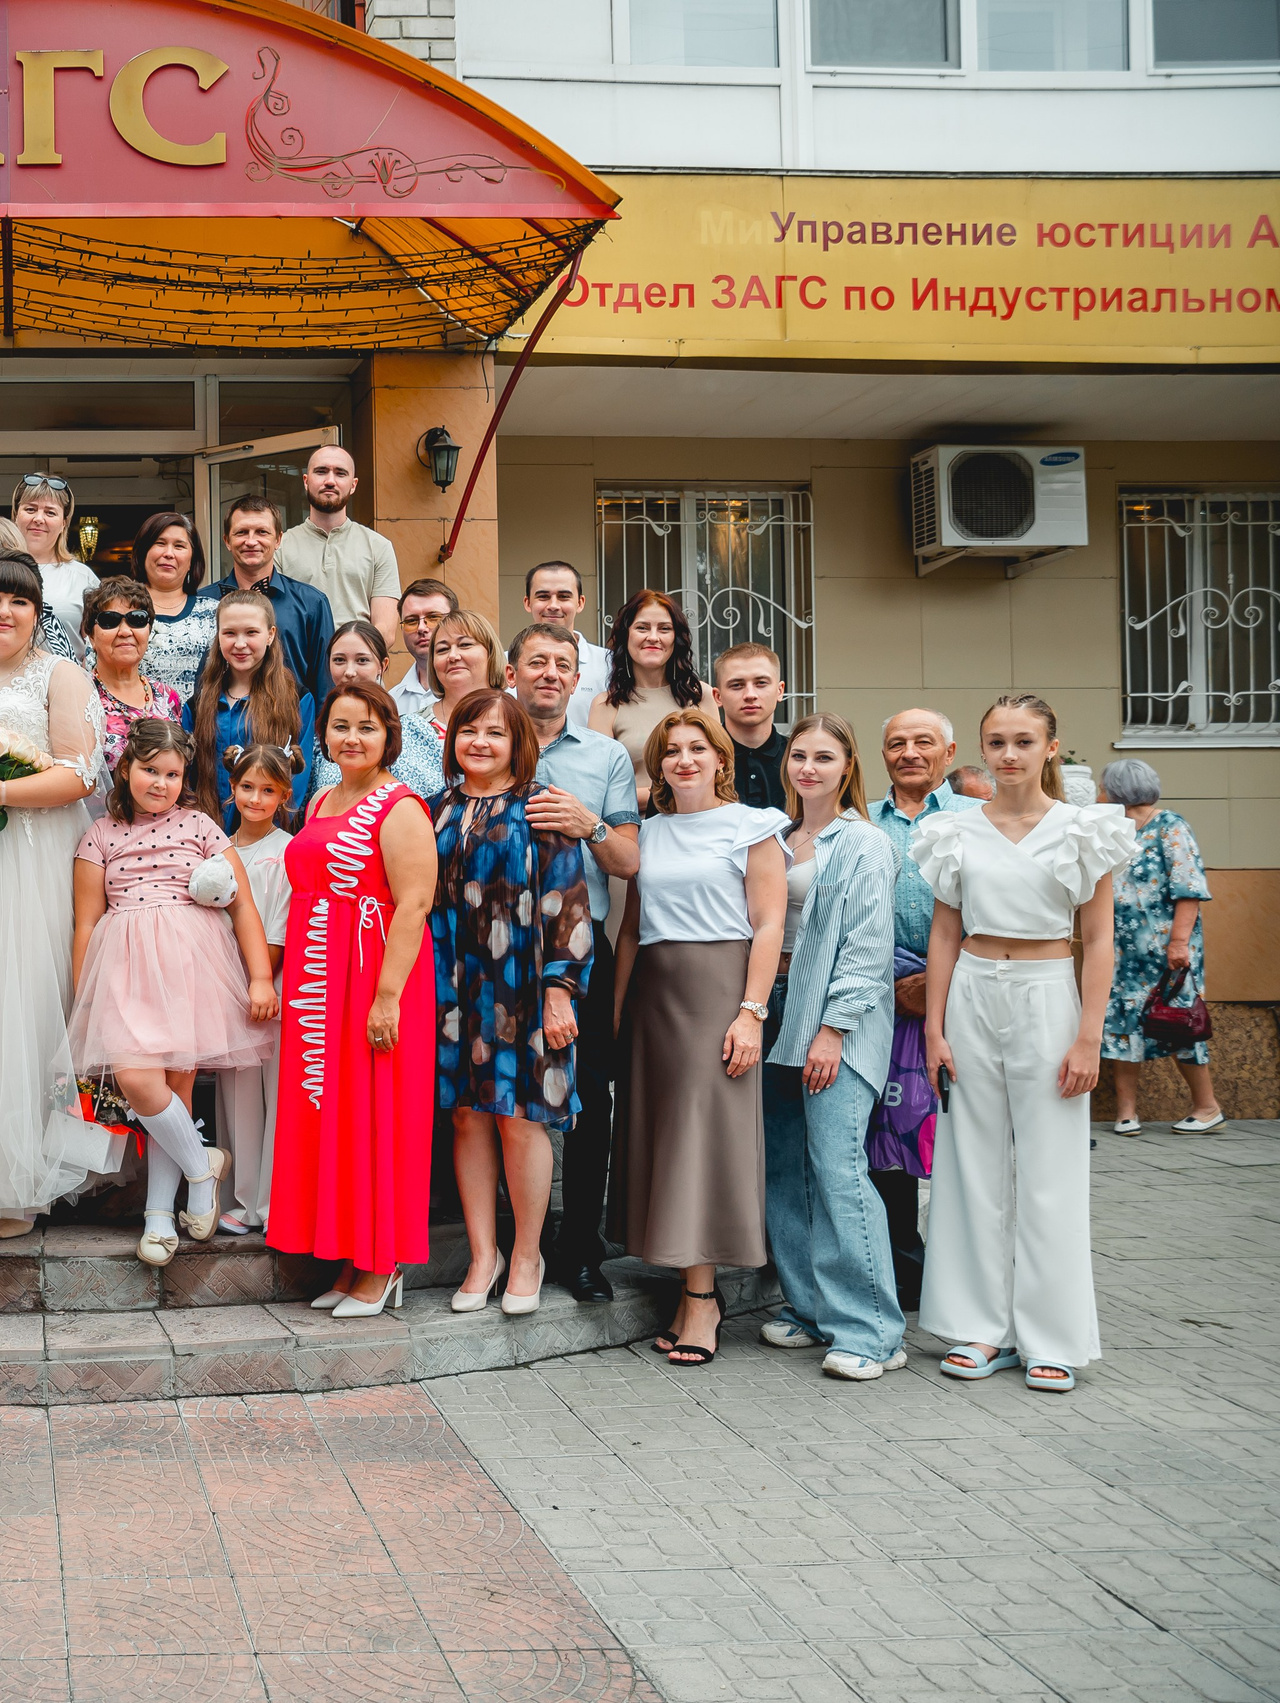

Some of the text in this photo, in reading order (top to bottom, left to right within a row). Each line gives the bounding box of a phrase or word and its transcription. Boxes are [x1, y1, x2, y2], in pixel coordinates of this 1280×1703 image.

[770, 211, 1017, 252] Управление
[1036, 221, 1232, 254] юстиции
[557, 273, 696, 314] Отдел
[710, 274, 828, 311] ЗАГС
[844, 285, 896, 312] по
